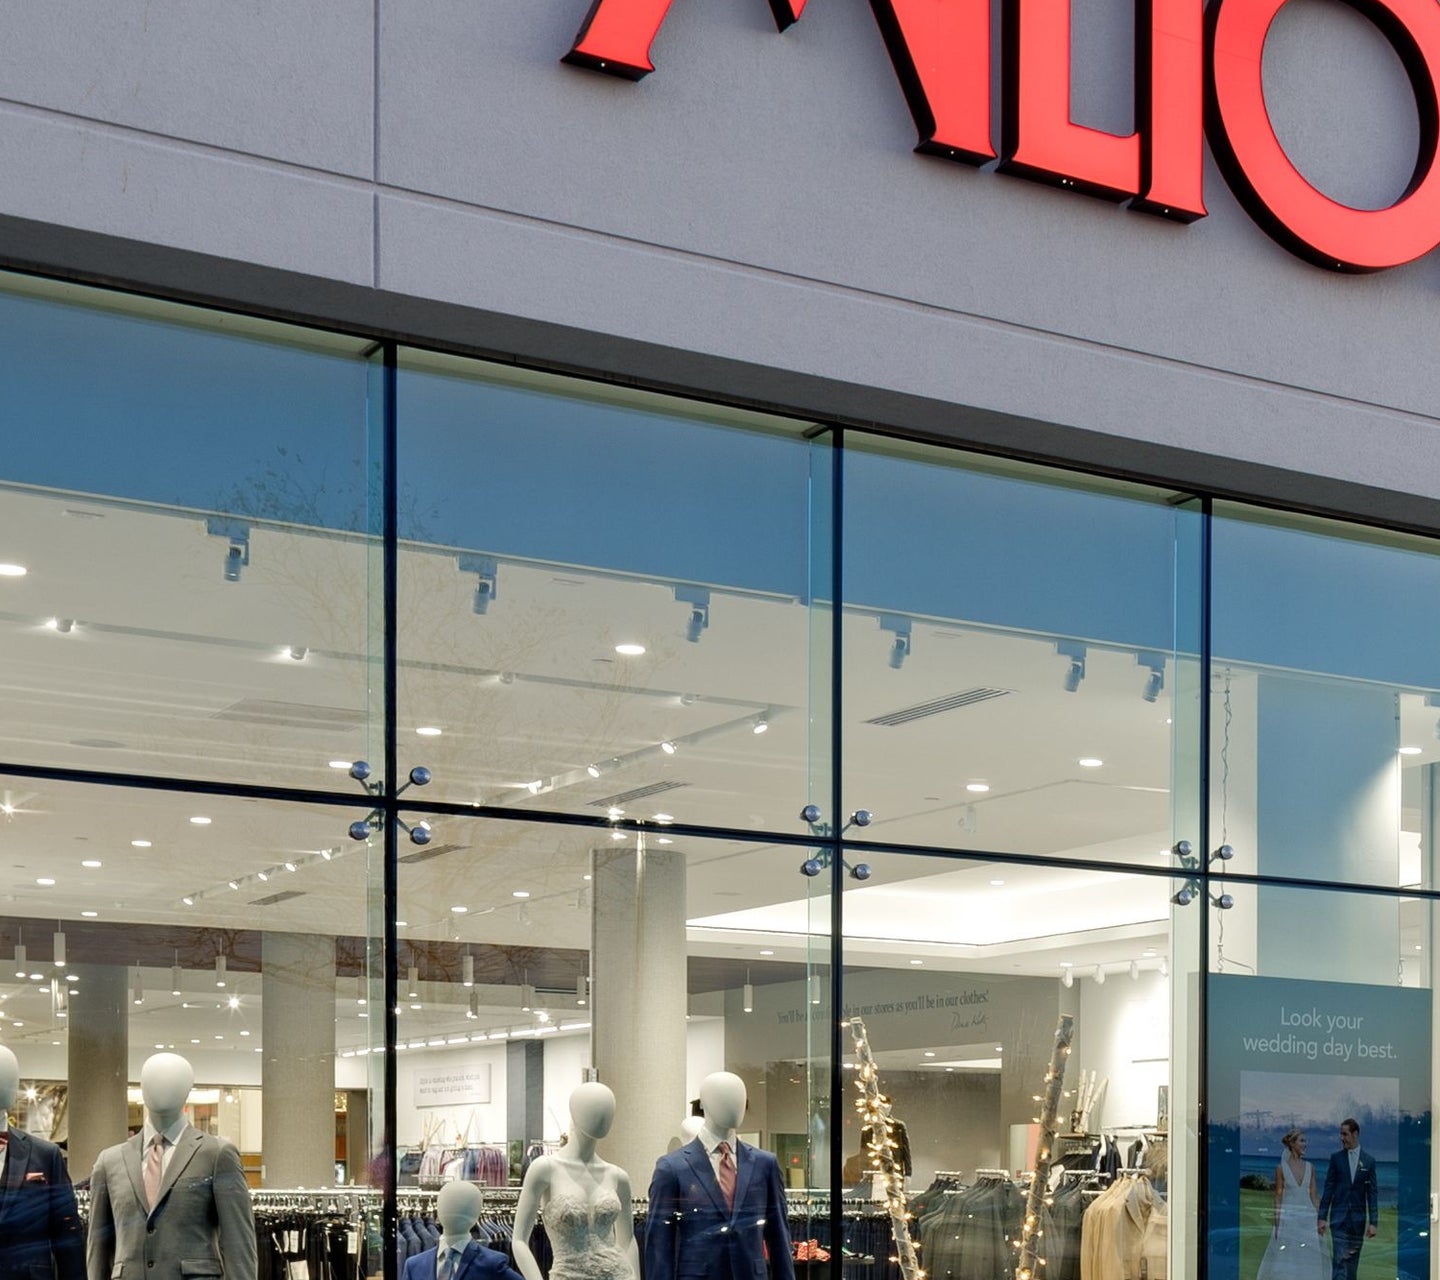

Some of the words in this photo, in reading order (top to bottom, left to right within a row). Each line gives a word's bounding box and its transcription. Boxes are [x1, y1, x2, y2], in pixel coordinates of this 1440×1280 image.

[1280, 1006, 1322, 1028] Look
[1326, 1014, 1364, 1033] your
[1242, 1033, 1318, 1060] wedding
[1323, 1036, 1353, 1062] day
[1357, 1037, 1397, 1060] best.
